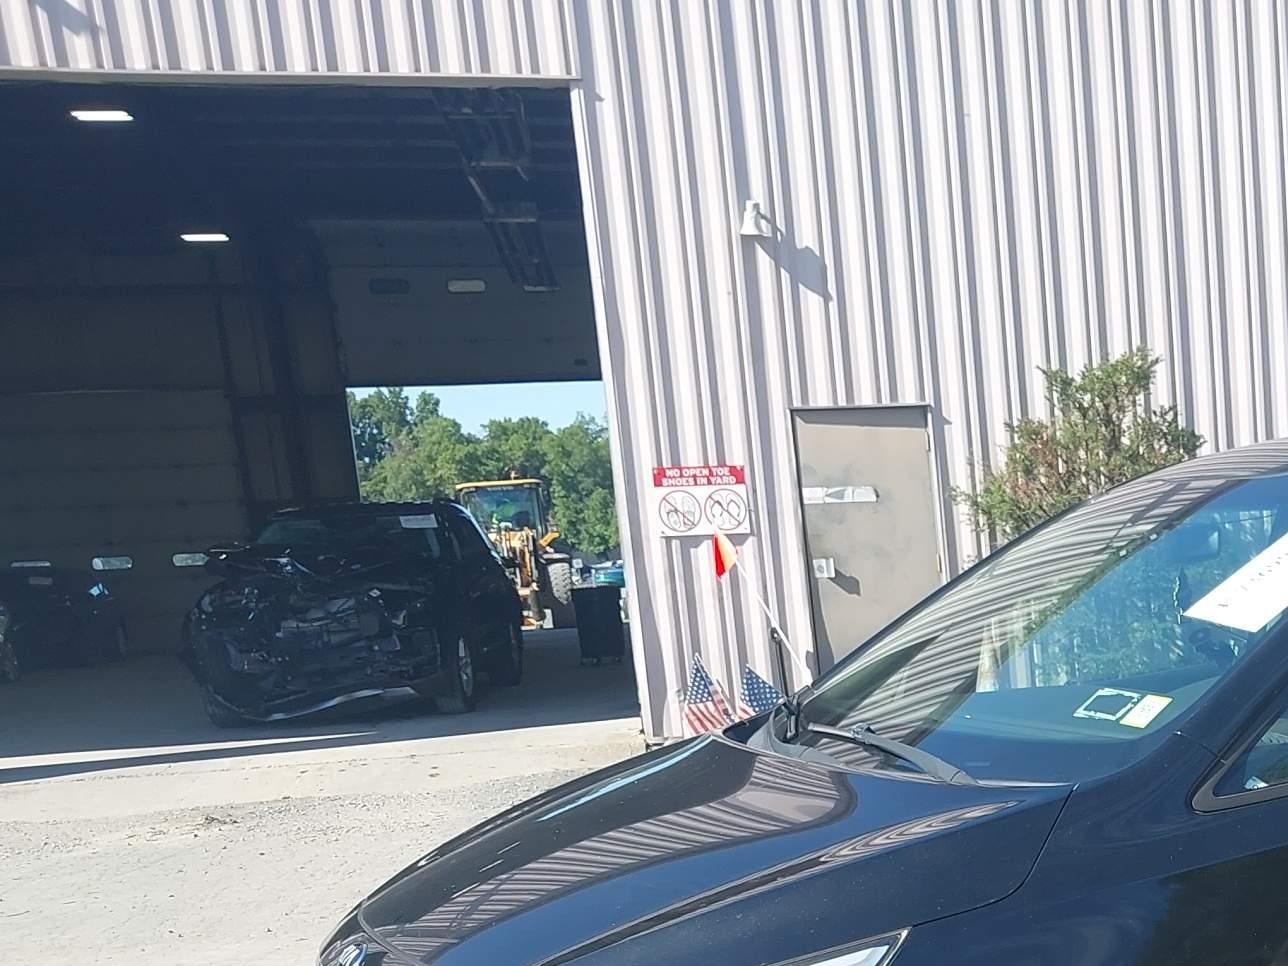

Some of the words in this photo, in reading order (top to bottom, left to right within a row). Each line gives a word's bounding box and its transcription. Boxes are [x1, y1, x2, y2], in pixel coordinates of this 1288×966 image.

[665, 468, 681, 477] NO
[682, 468, 710, 477] OPEN
[711, 467, 731, 476] TOE
[661, 477, 695, 486] SHOES
[696, 477, 708, 485] IN
[709, 476, 737, 485] YARD
